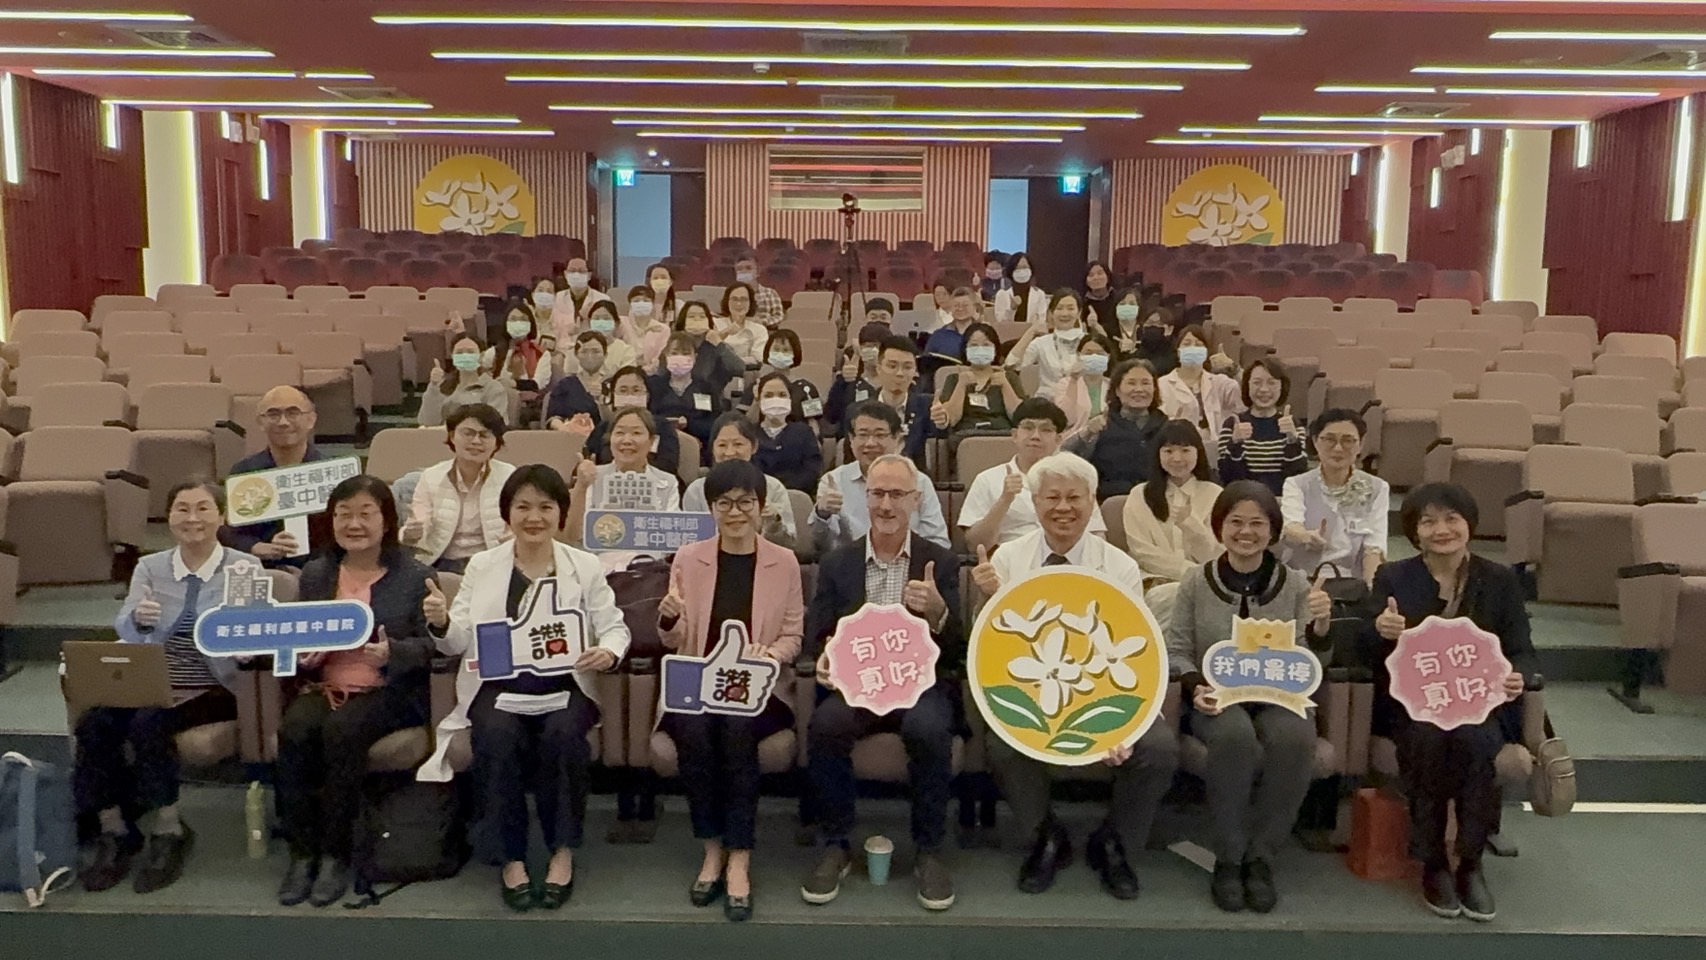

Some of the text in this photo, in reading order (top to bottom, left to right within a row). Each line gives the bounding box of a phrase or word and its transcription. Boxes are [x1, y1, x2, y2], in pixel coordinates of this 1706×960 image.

[275, 462, 356, 489] 衛生福利部
[633, 516, 699, 531] 衛生福利部
[216, 618, 355, 638] 衛生福利部臺中醫院
[528, 621, 569, 660] 讚
[850, 628, 911, 662] 有你
[1411, 643, 1478, 677] 有你
[712, 666, 752, 705] 讚
[856, 660, 919, 695] 真好
[1213, 655, 1312, 684] 我們最棒
[1420, 676, 1489, 709] 真好
